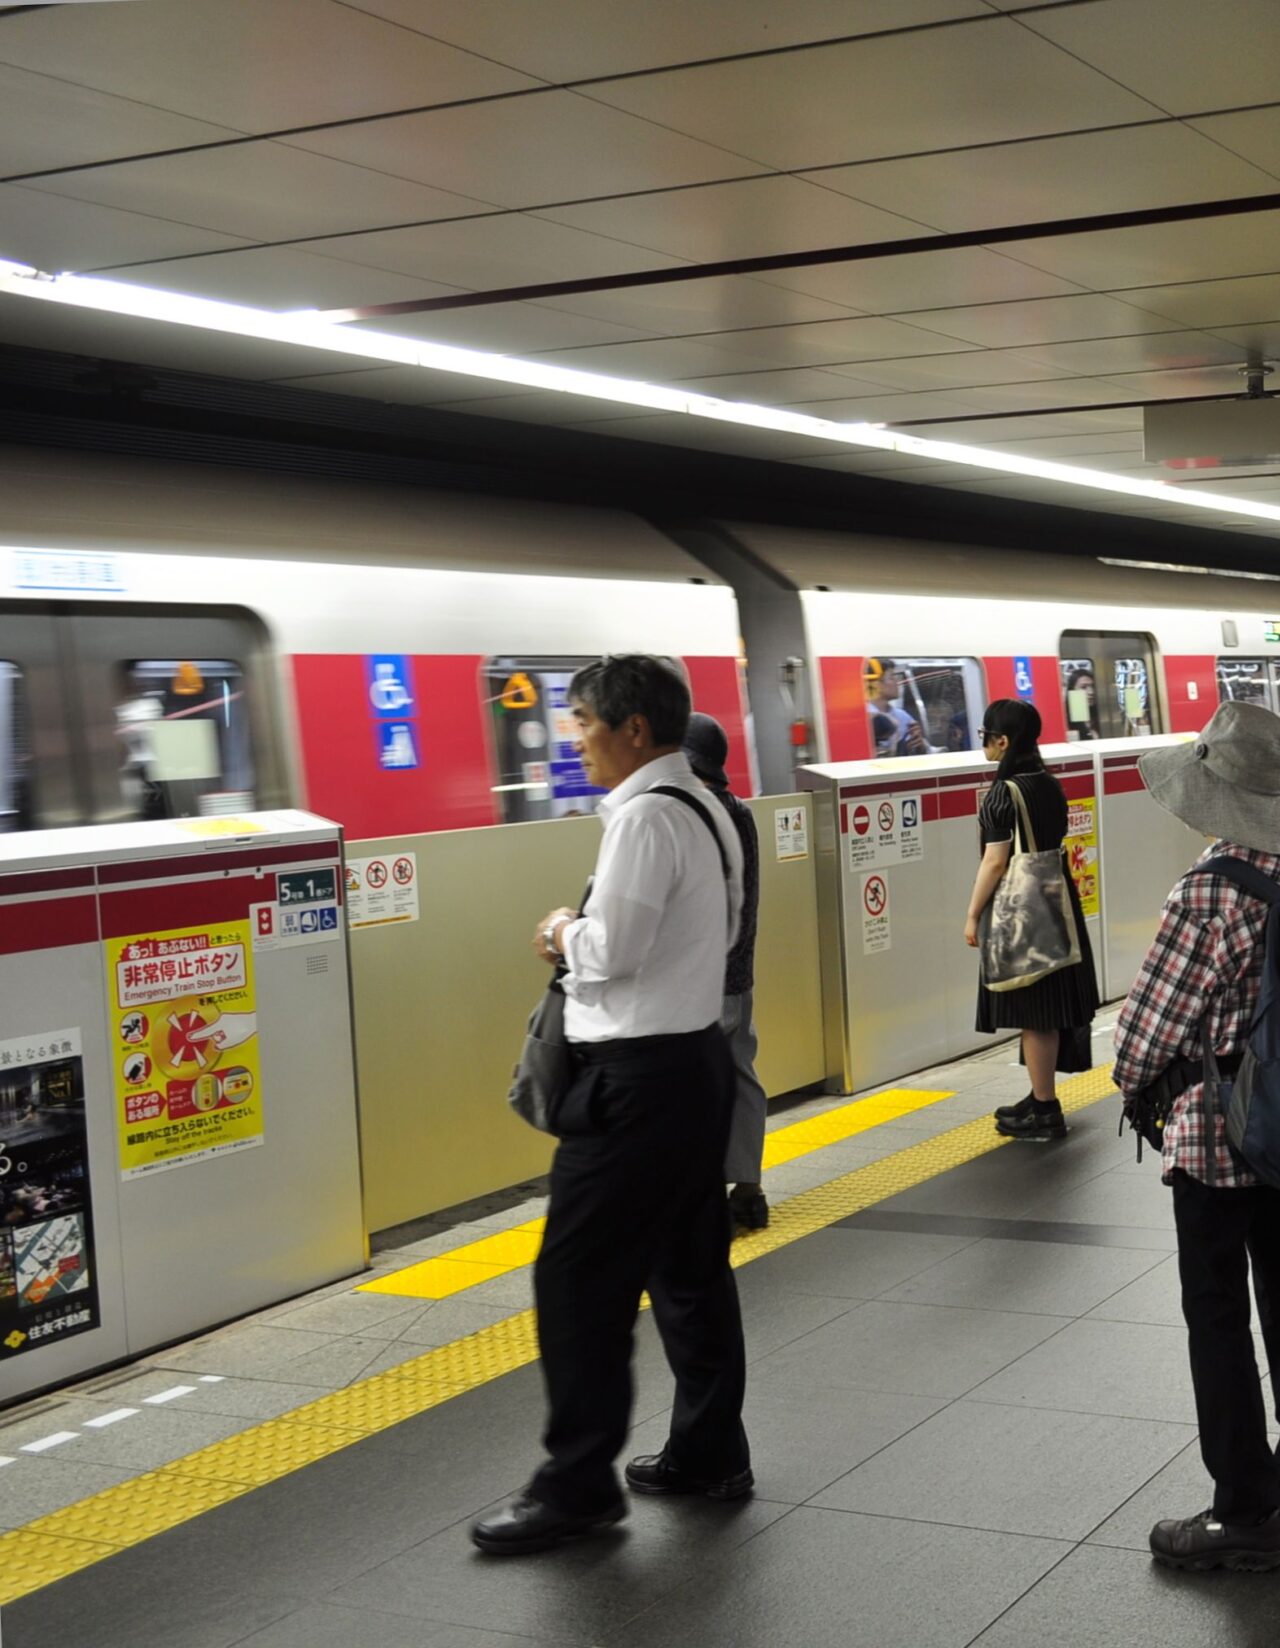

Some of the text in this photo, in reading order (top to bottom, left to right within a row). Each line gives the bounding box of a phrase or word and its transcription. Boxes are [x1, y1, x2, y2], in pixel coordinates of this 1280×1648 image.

[124, 952, 239, 987] 非常停止ボタン
[125, 973, 242, 1001] Emergency Train Stop Button
[28, 1309, 91, 1340] 住友不動産
